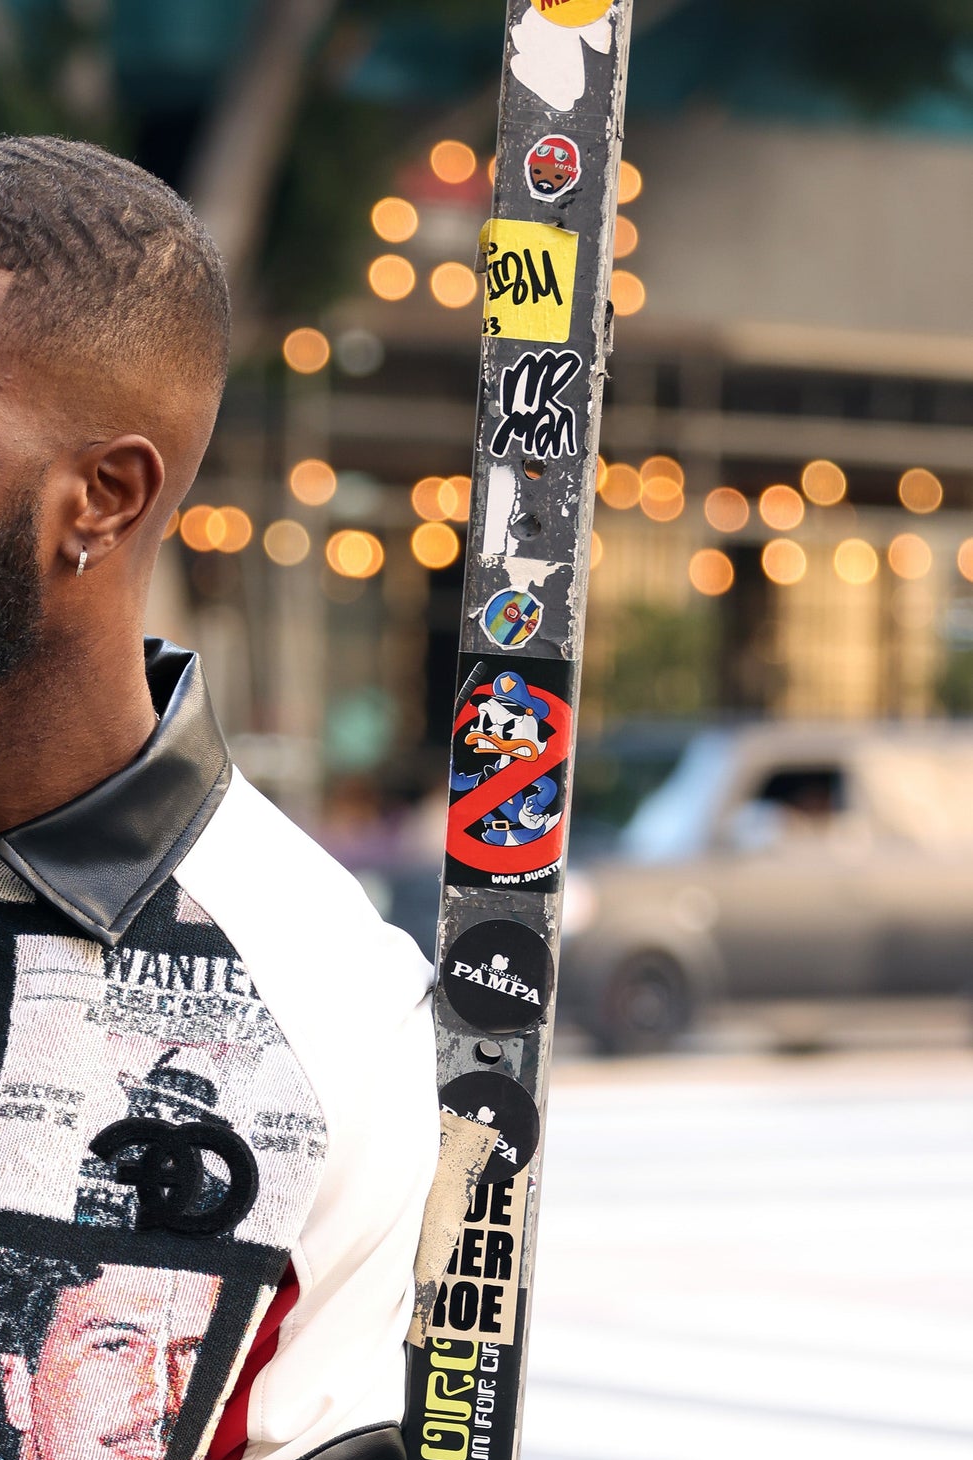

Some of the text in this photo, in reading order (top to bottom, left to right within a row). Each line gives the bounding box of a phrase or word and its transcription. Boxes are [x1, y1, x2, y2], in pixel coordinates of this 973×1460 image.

[450, 960, 541, 1006] PAMPA
[480, 961, 522, 983] Records
[474, 1378, 497, 1429] FOR
